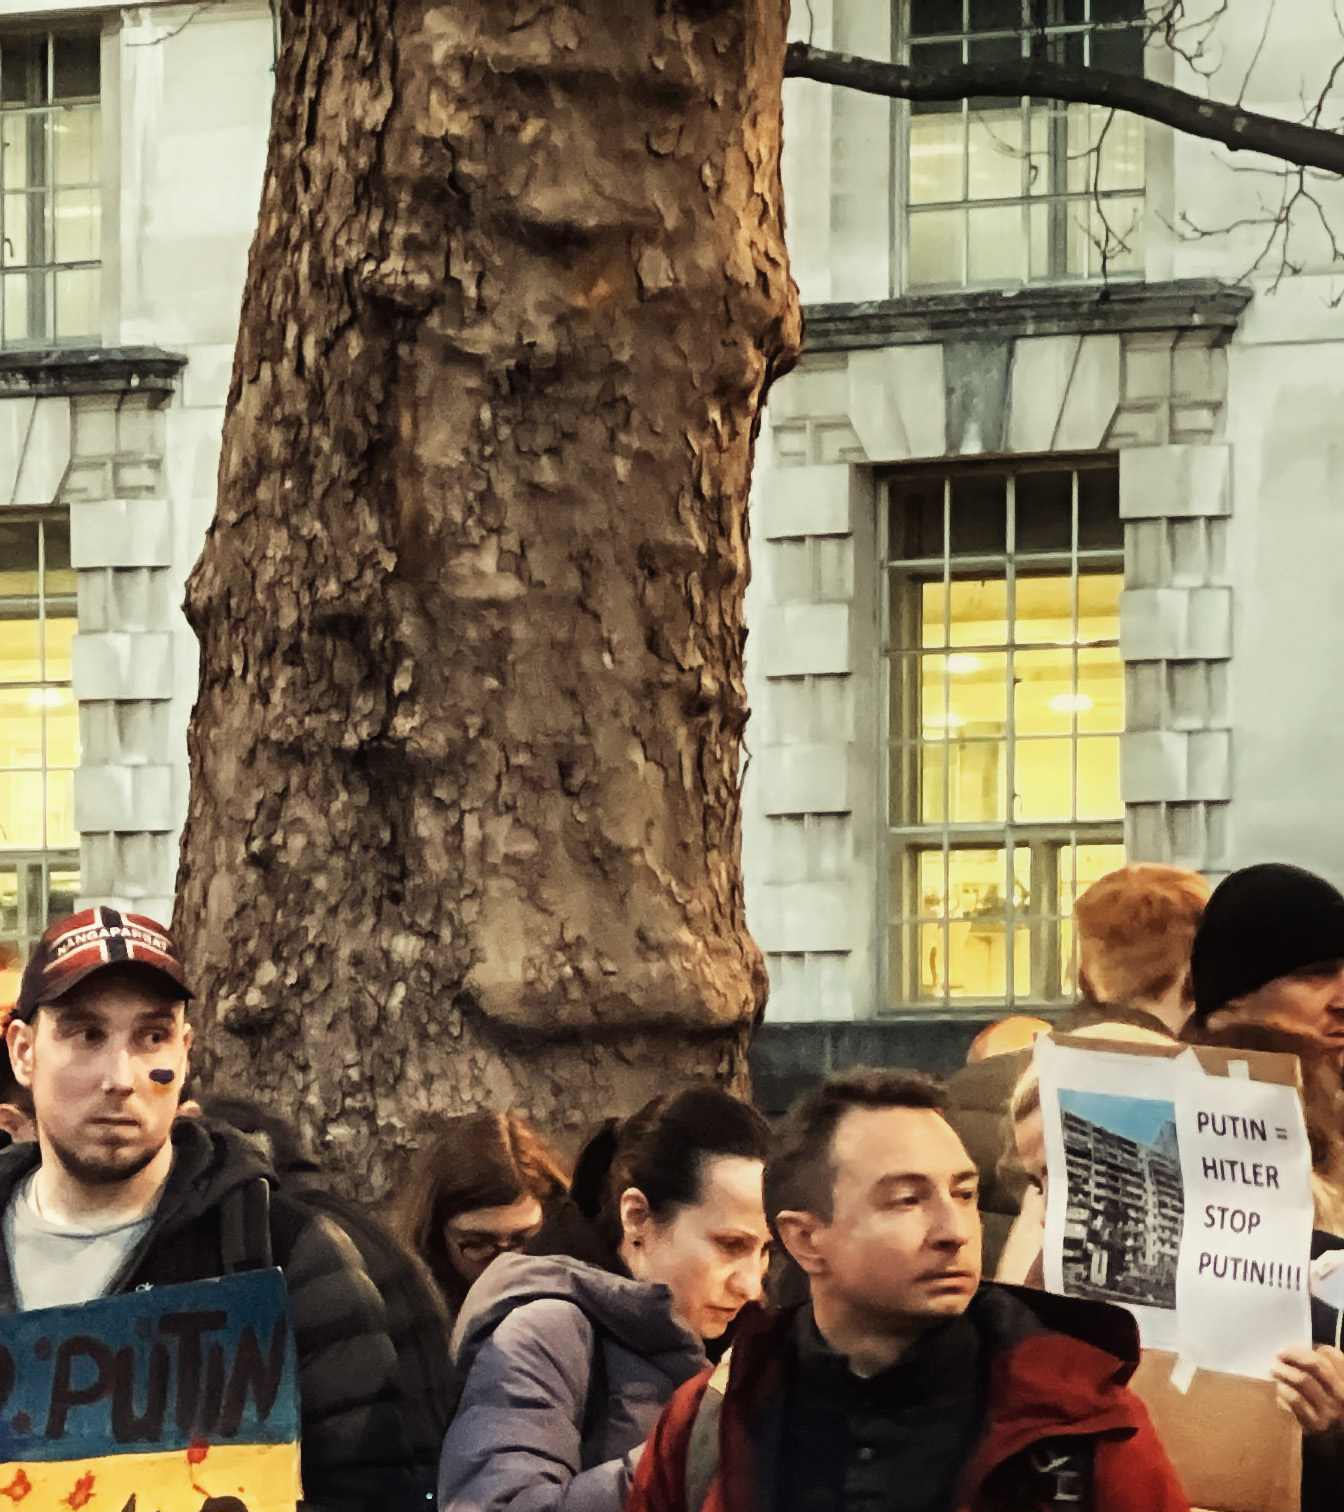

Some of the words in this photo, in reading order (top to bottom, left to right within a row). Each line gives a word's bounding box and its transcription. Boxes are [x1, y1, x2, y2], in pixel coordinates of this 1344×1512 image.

[1196, 1110, 1267, 1142] PUTIN
[1201, 1156, 1280, 1190] HITLER
[1204, 1205, 1261, 1235] STOP
[1198, 1251, 1302, 1292] PUTIN!!!!
[44, 1309, 286, 1441] PUTIN
